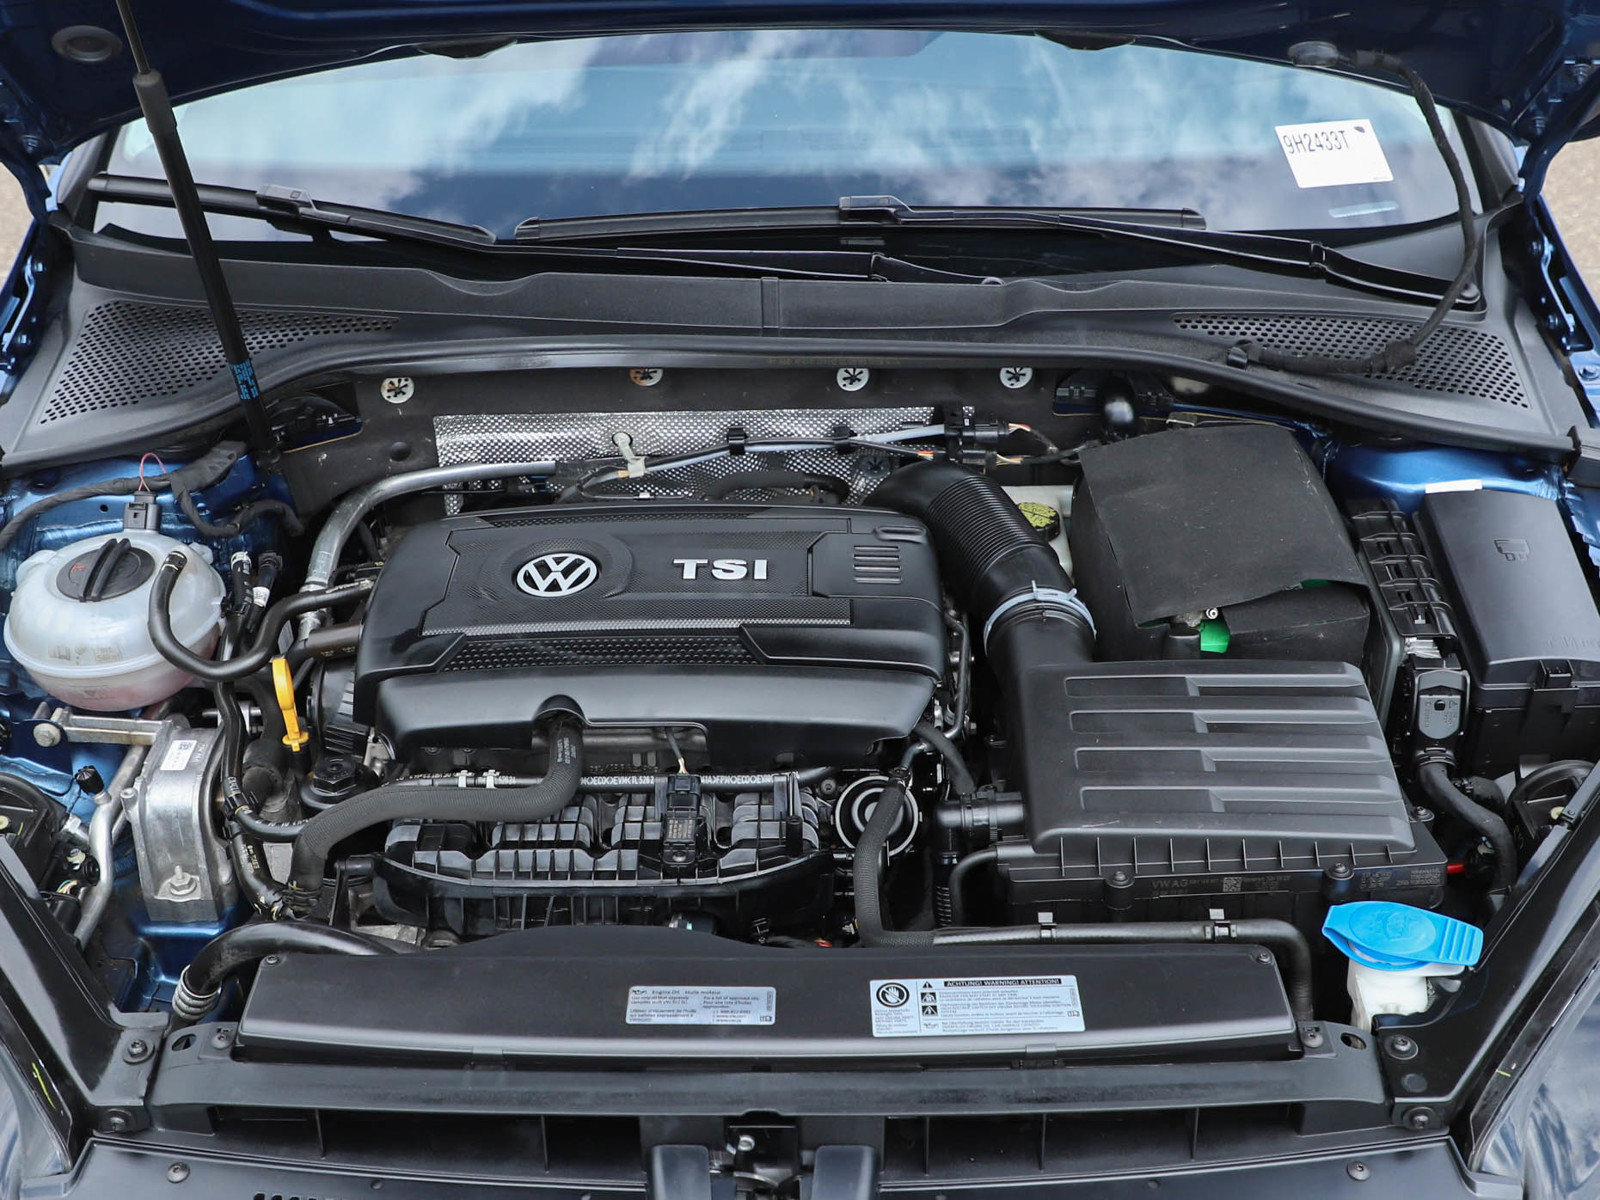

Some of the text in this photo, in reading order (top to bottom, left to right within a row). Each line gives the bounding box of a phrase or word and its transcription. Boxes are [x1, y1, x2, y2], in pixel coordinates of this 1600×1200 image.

[1282, 129, 1349, 154] 9H2433T
[673, 558, 768, 580] TSI
[1020, 978, 1059, 986] ATTENTION!
